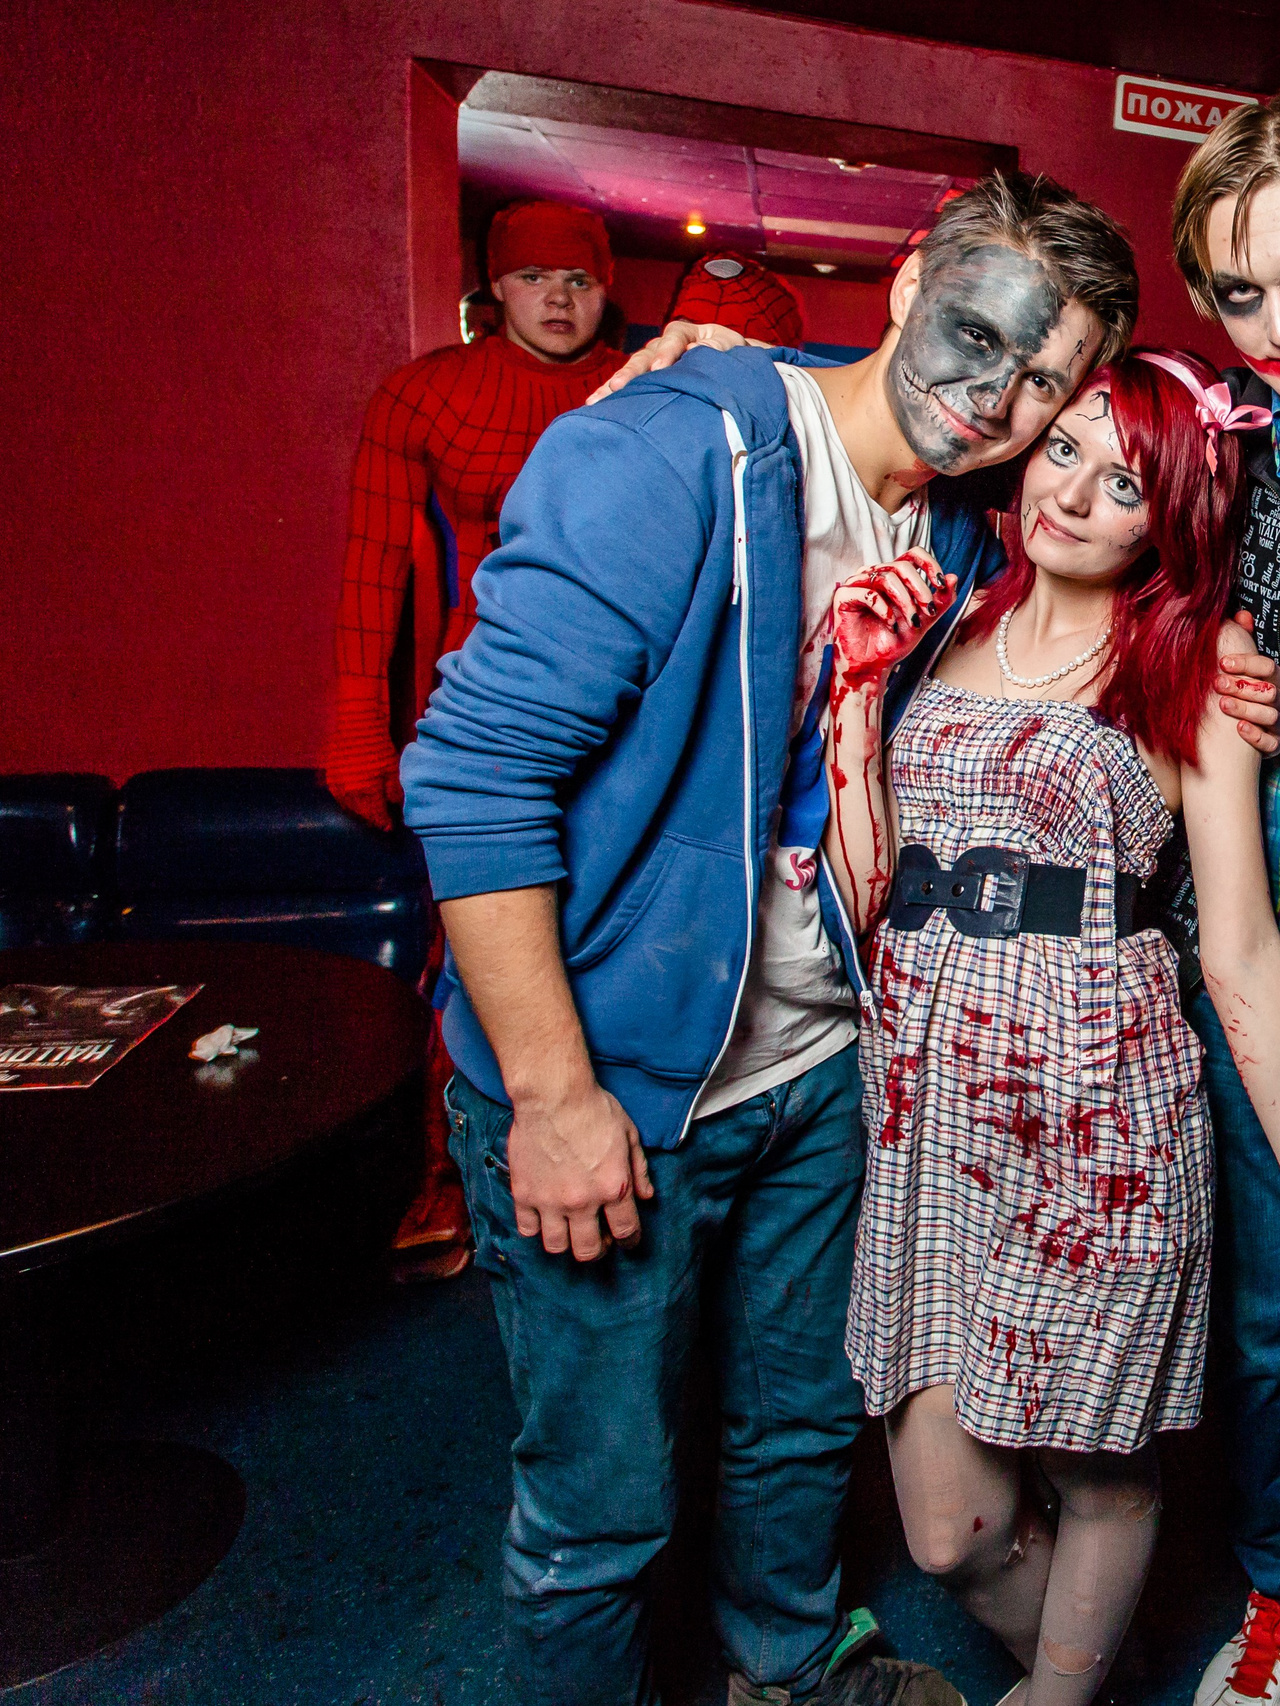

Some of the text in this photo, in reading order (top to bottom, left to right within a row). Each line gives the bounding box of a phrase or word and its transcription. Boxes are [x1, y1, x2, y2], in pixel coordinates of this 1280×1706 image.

[1127, 92, 1233, 127] ПОЖА
[1258, 522, 1280, 541] ITALY
[1261, 562, 1274, 585] Blue
[1239, 577, 1259, 593] PORT
